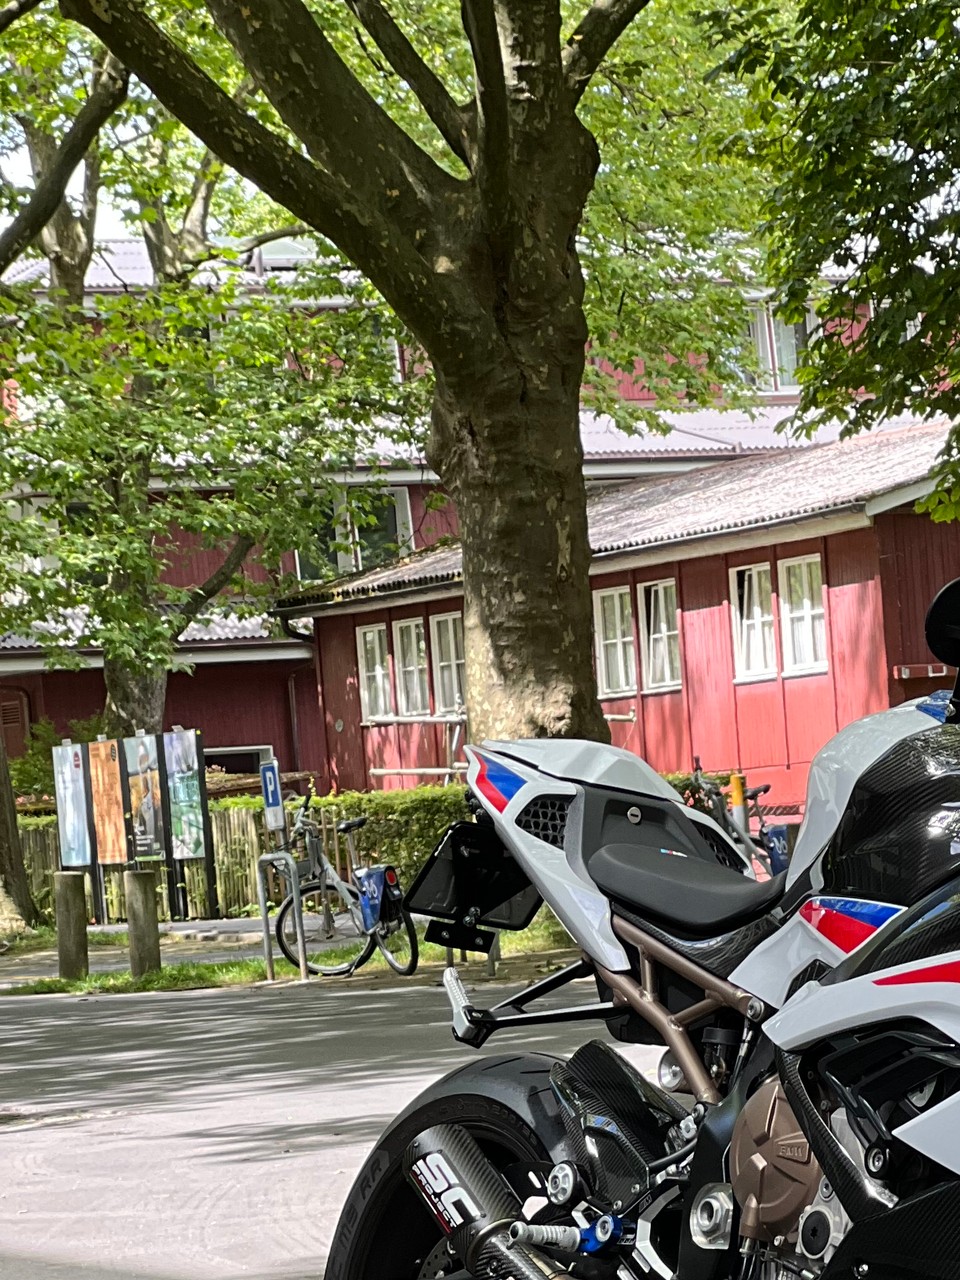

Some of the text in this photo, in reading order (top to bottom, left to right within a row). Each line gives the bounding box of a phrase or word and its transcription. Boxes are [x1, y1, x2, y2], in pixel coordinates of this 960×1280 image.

[265, 771, 275, 803] P
[779, 1146, 804, 1158] BMW
[359, 1157, 382, 1200] RR
[411, 1164, 457, 1228] PROJECT
[416, 1152, 481, 1226] SC
